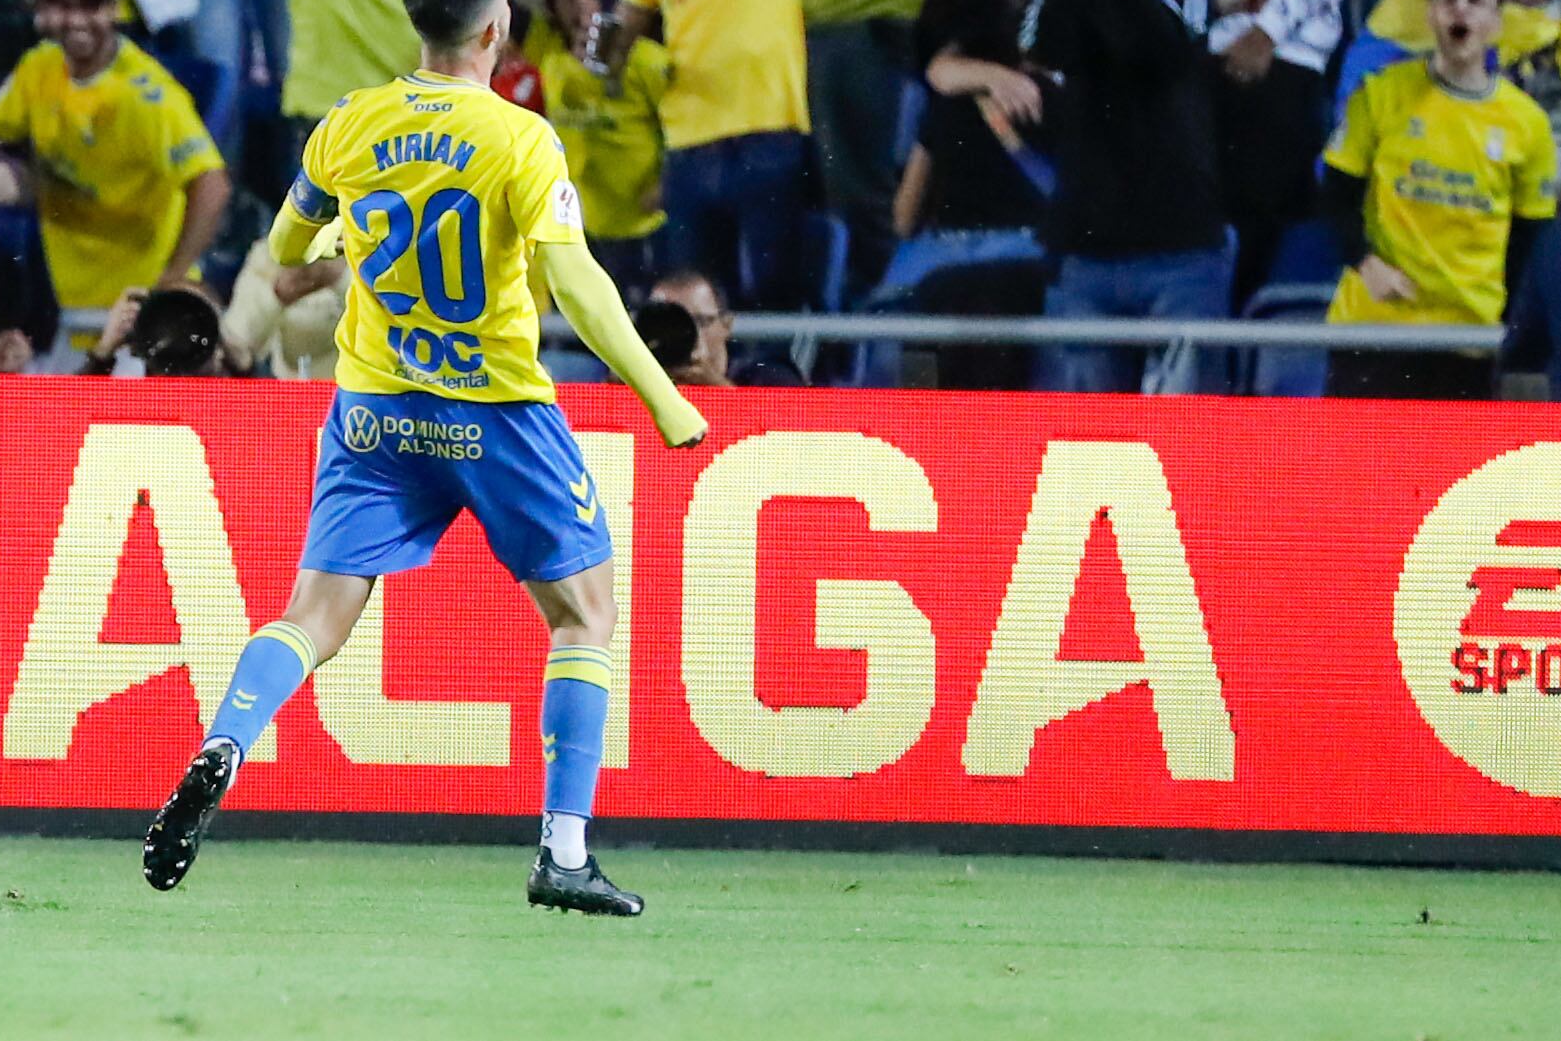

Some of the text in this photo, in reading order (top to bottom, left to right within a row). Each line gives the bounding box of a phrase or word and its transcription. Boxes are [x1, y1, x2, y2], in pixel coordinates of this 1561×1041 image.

[372, 131, 476, 173] KIRIAN
[350, 187, 486, 324] 20
[383, 416, 482, 441] DOMINGO
[398, 439, 483, 460] ALONSO
